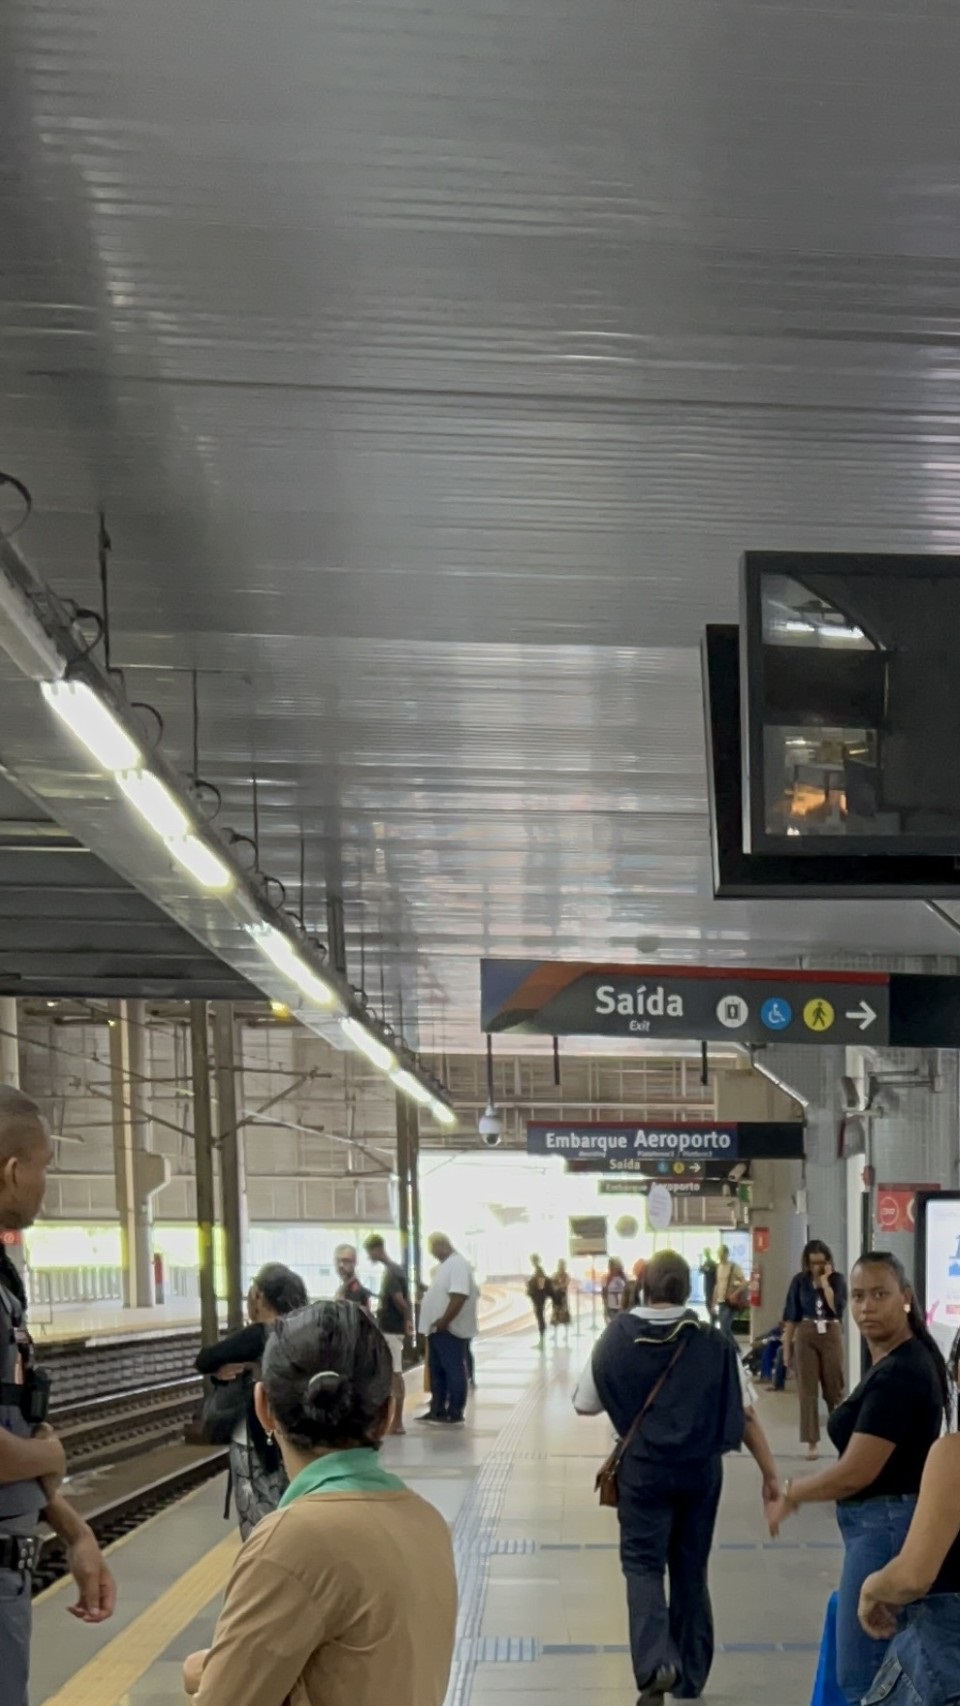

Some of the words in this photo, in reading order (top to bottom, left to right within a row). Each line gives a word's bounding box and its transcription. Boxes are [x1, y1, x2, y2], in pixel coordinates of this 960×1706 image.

[595, 985, 684, 1017] Saída
[629, 1020, 651, 1032] Exit
[546, 1132, 627, 1151] Embarque
[634, 1129, 731, 1151] Aeroporto
[609, 1158, 640, 1171] Saída
[651, 1181, 700, 1193] Aroporto
